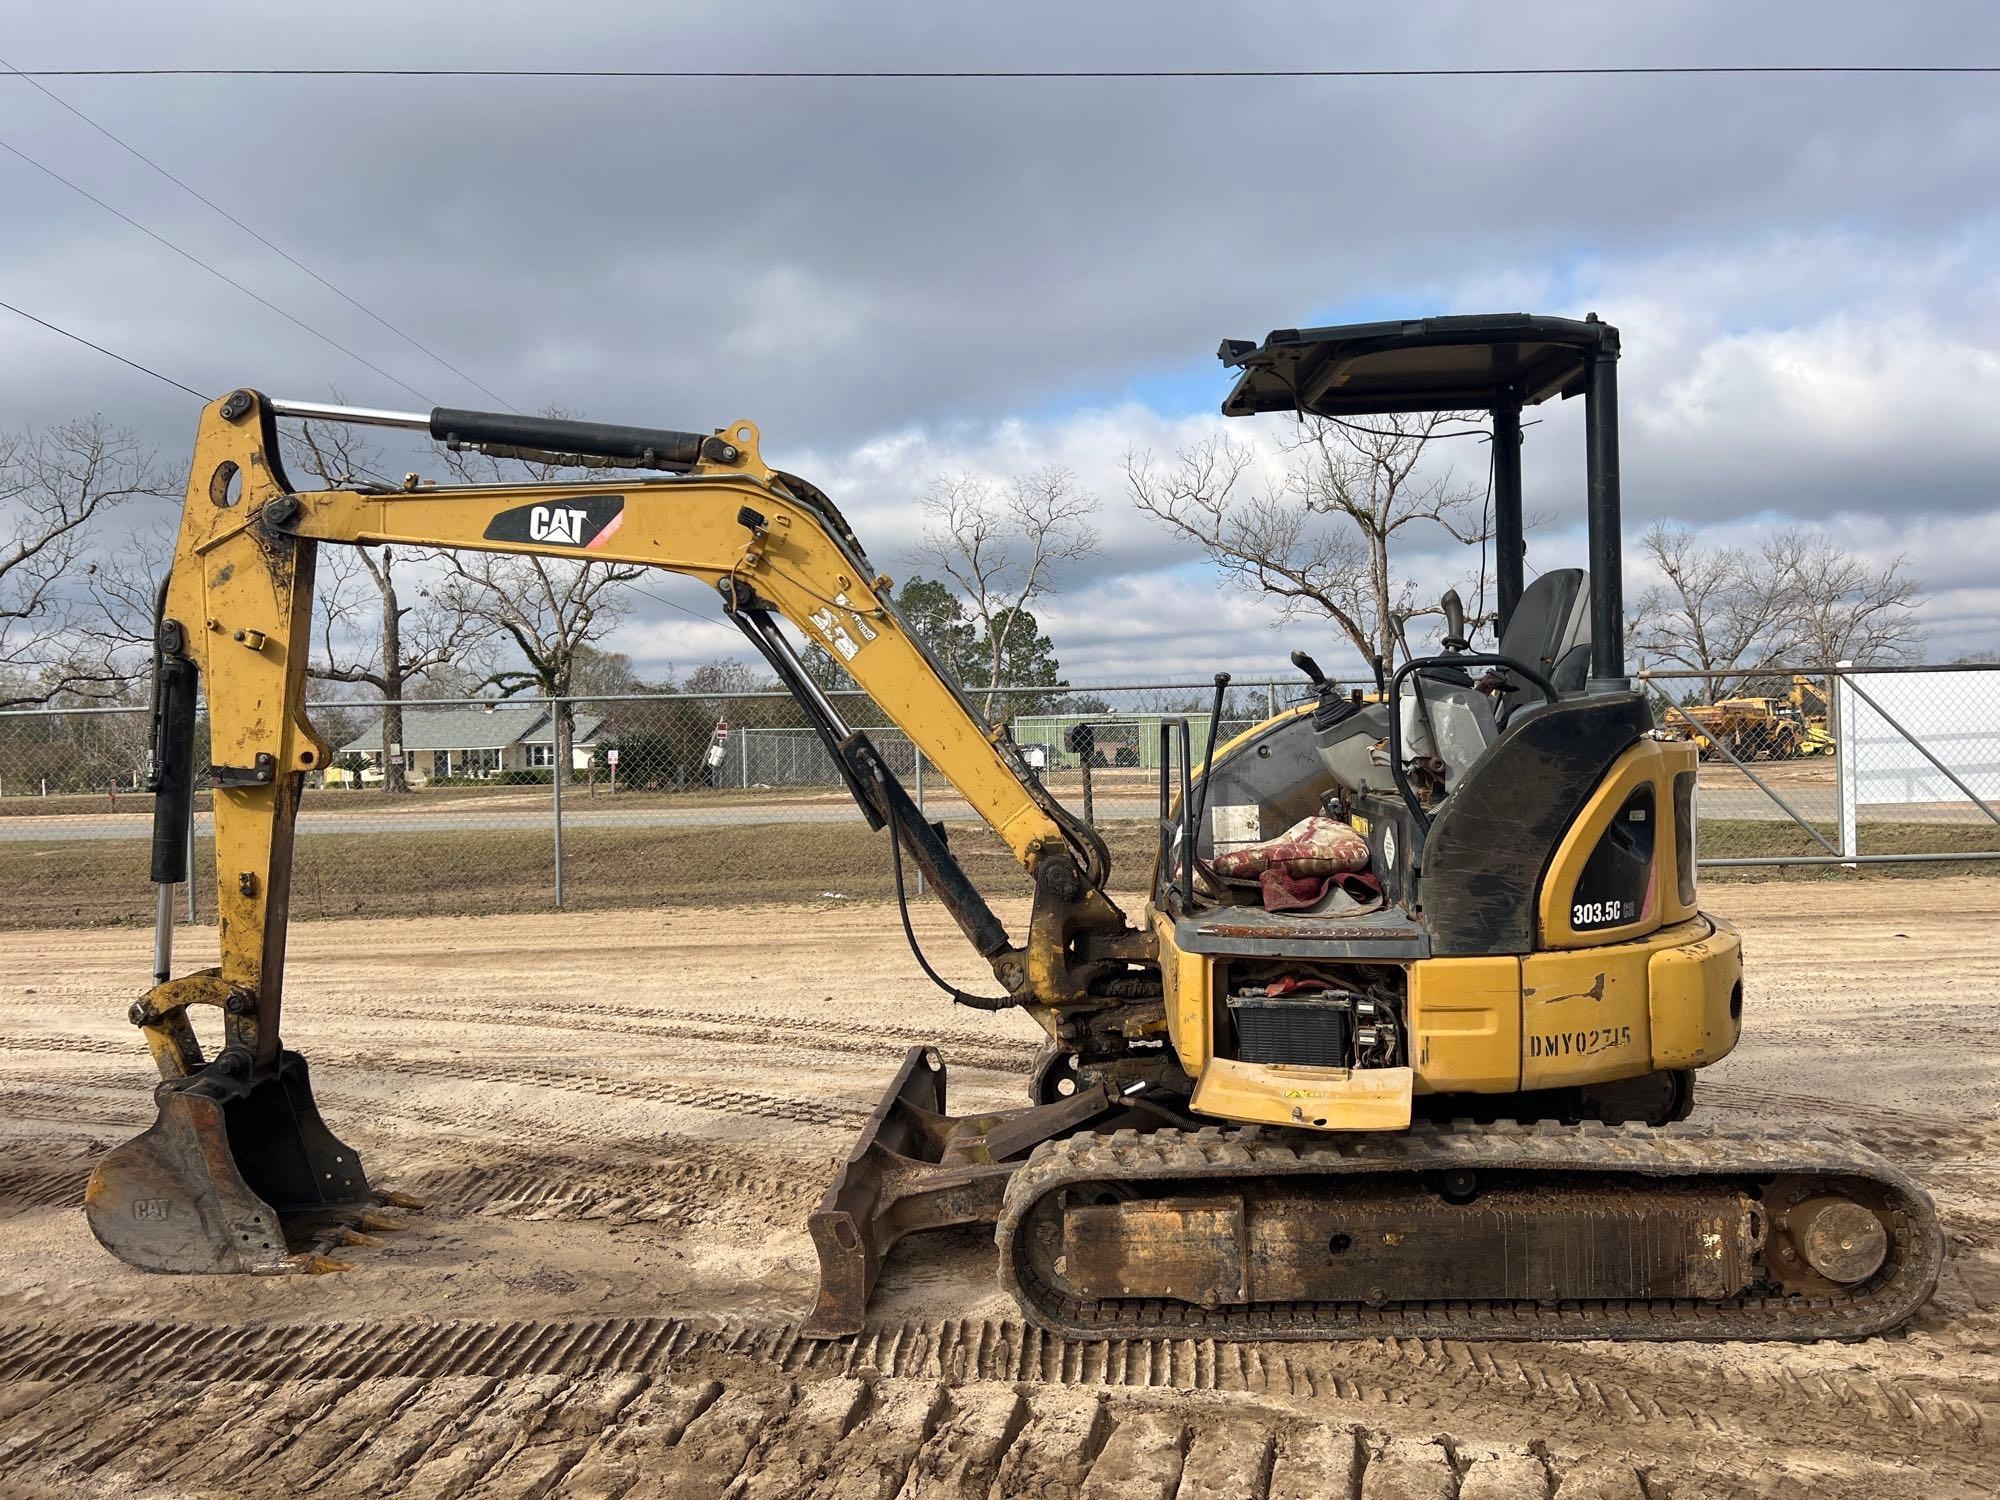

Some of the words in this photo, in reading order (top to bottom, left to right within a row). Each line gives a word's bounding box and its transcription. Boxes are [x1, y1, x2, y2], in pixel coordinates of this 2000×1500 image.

[529, 506, 587, 544] CAT
[1573, 900, 1621, 925] 303.5C
[134, 1199, 169, 1222] CAT
